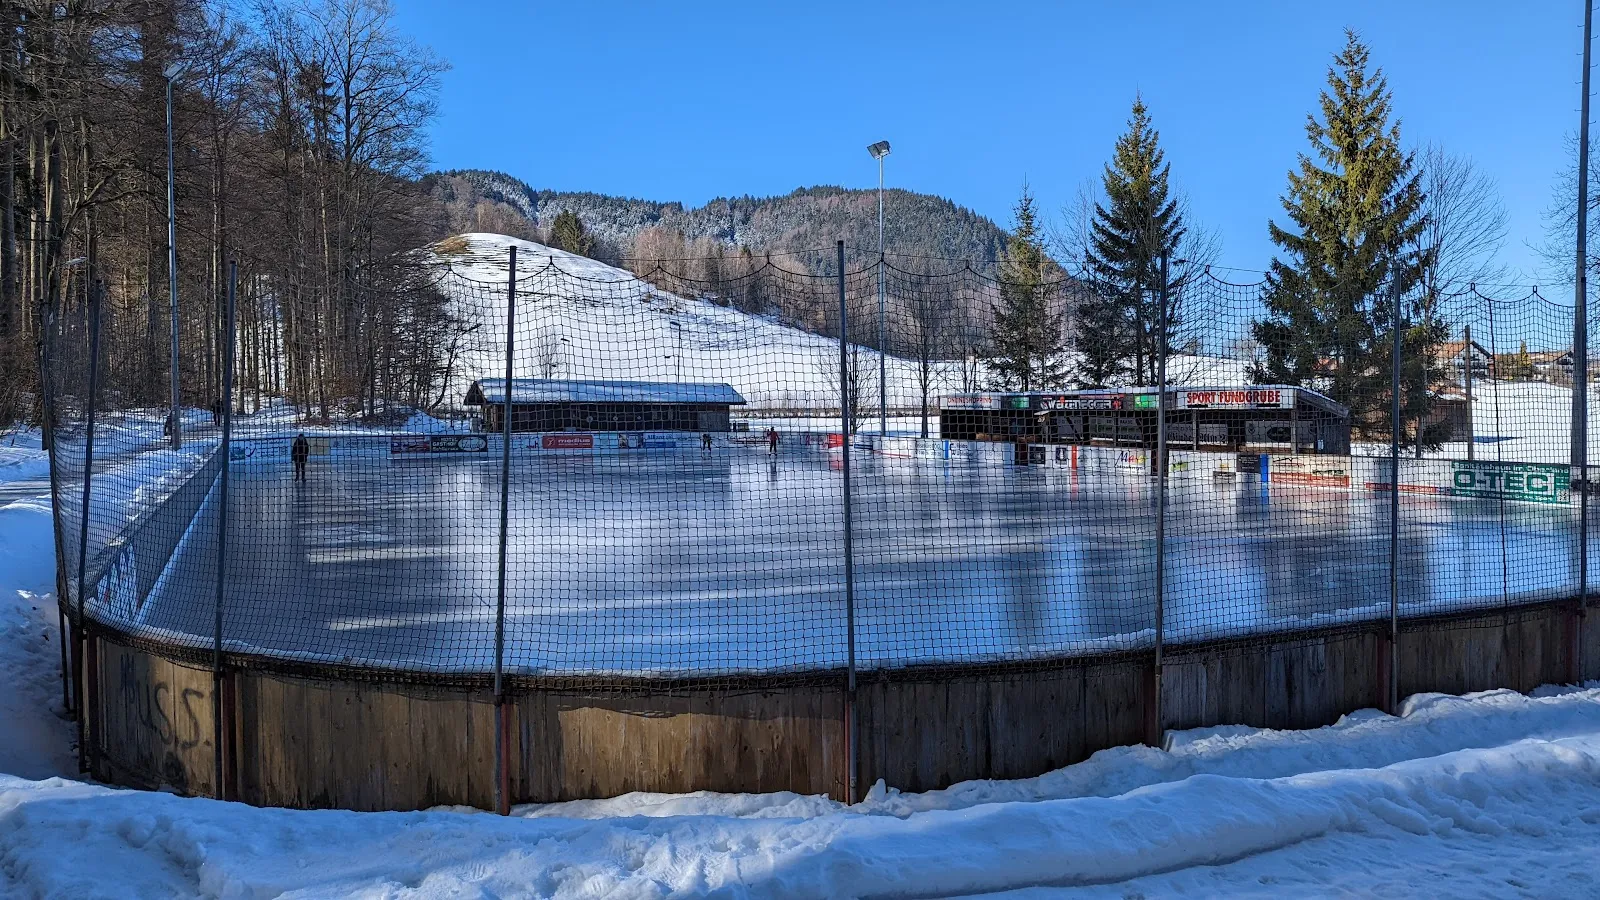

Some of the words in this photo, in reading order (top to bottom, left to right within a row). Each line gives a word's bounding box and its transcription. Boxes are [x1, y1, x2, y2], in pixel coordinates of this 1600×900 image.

[1187, 391, 1217, 404] SPORT
[1219, 390, 1280, 403] FUNDGRUBE
[1454, 470, 1549, 492] O-TEC
